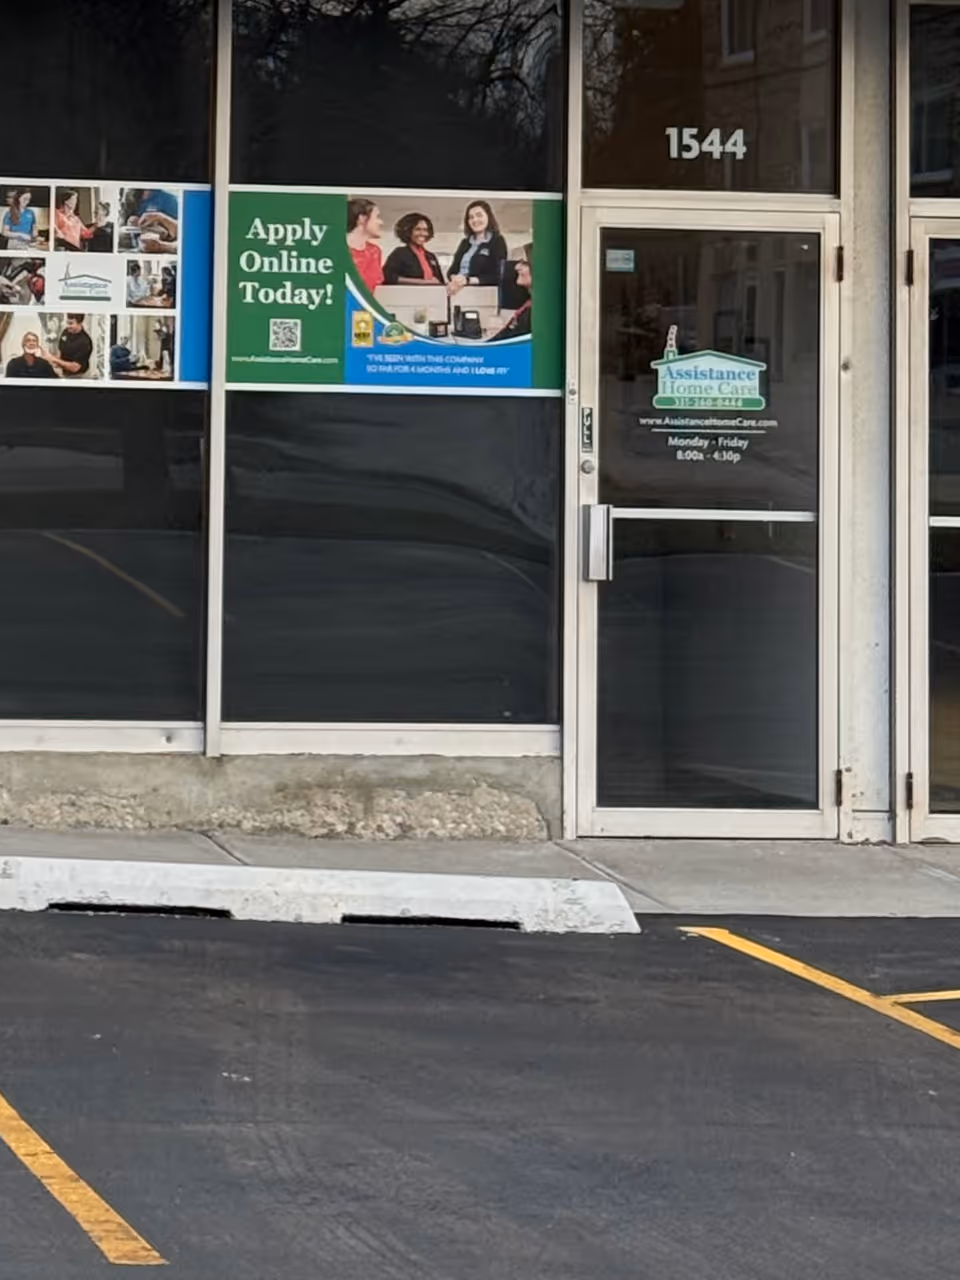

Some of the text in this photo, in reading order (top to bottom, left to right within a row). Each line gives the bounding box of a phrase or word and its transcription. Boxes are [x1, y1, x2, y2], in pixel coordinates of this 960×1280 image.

[665, 127, 748, 160] 1544
[245, 217, 329, 247] Apply
[239, 250, 334, 275] Online
[238, 281, 334, 310] Today!
[660, 365, 757, 381] Assistance
[660, 381, 759, 397] Home Care
[667, 436, 711, 449] Monday
[717, 437, 750, 451] Friday
